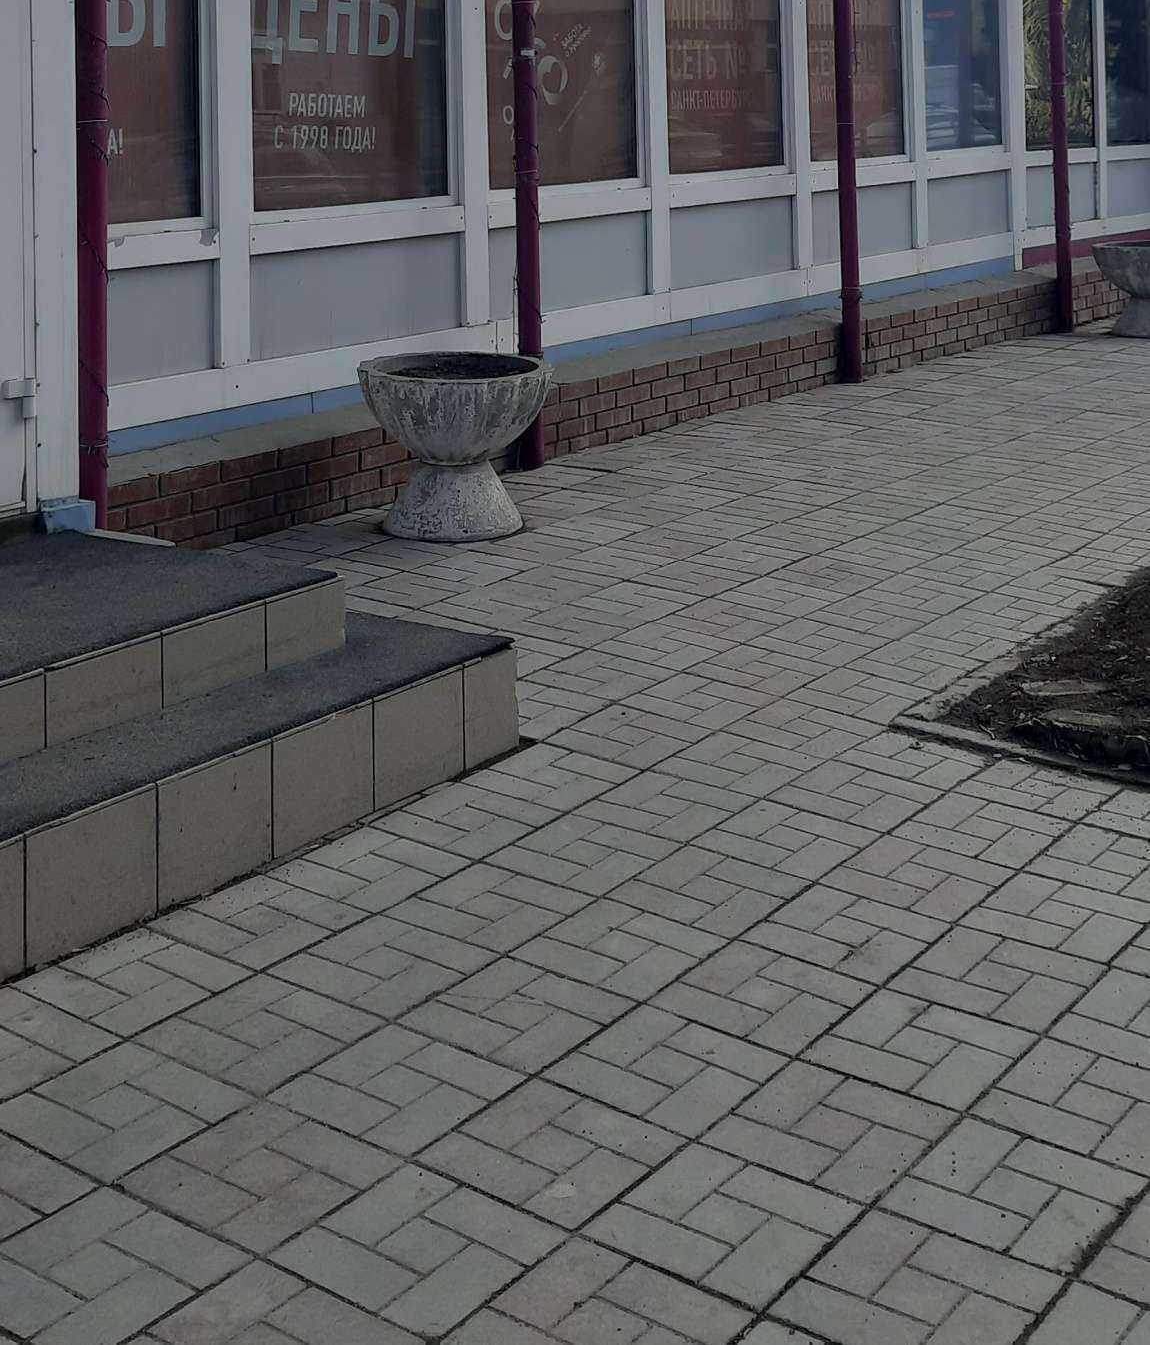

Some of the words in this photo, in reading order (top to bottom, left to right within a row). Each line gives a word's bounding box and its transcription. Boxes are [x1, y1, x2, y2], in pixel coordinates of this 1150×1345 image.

[287, 92, 366, 118] РАБОТАЕМ
[274, 124, 285, 149] С
[290, 124, 329, 150] 1998
[334, 125, 377, 153] ГОДА!
